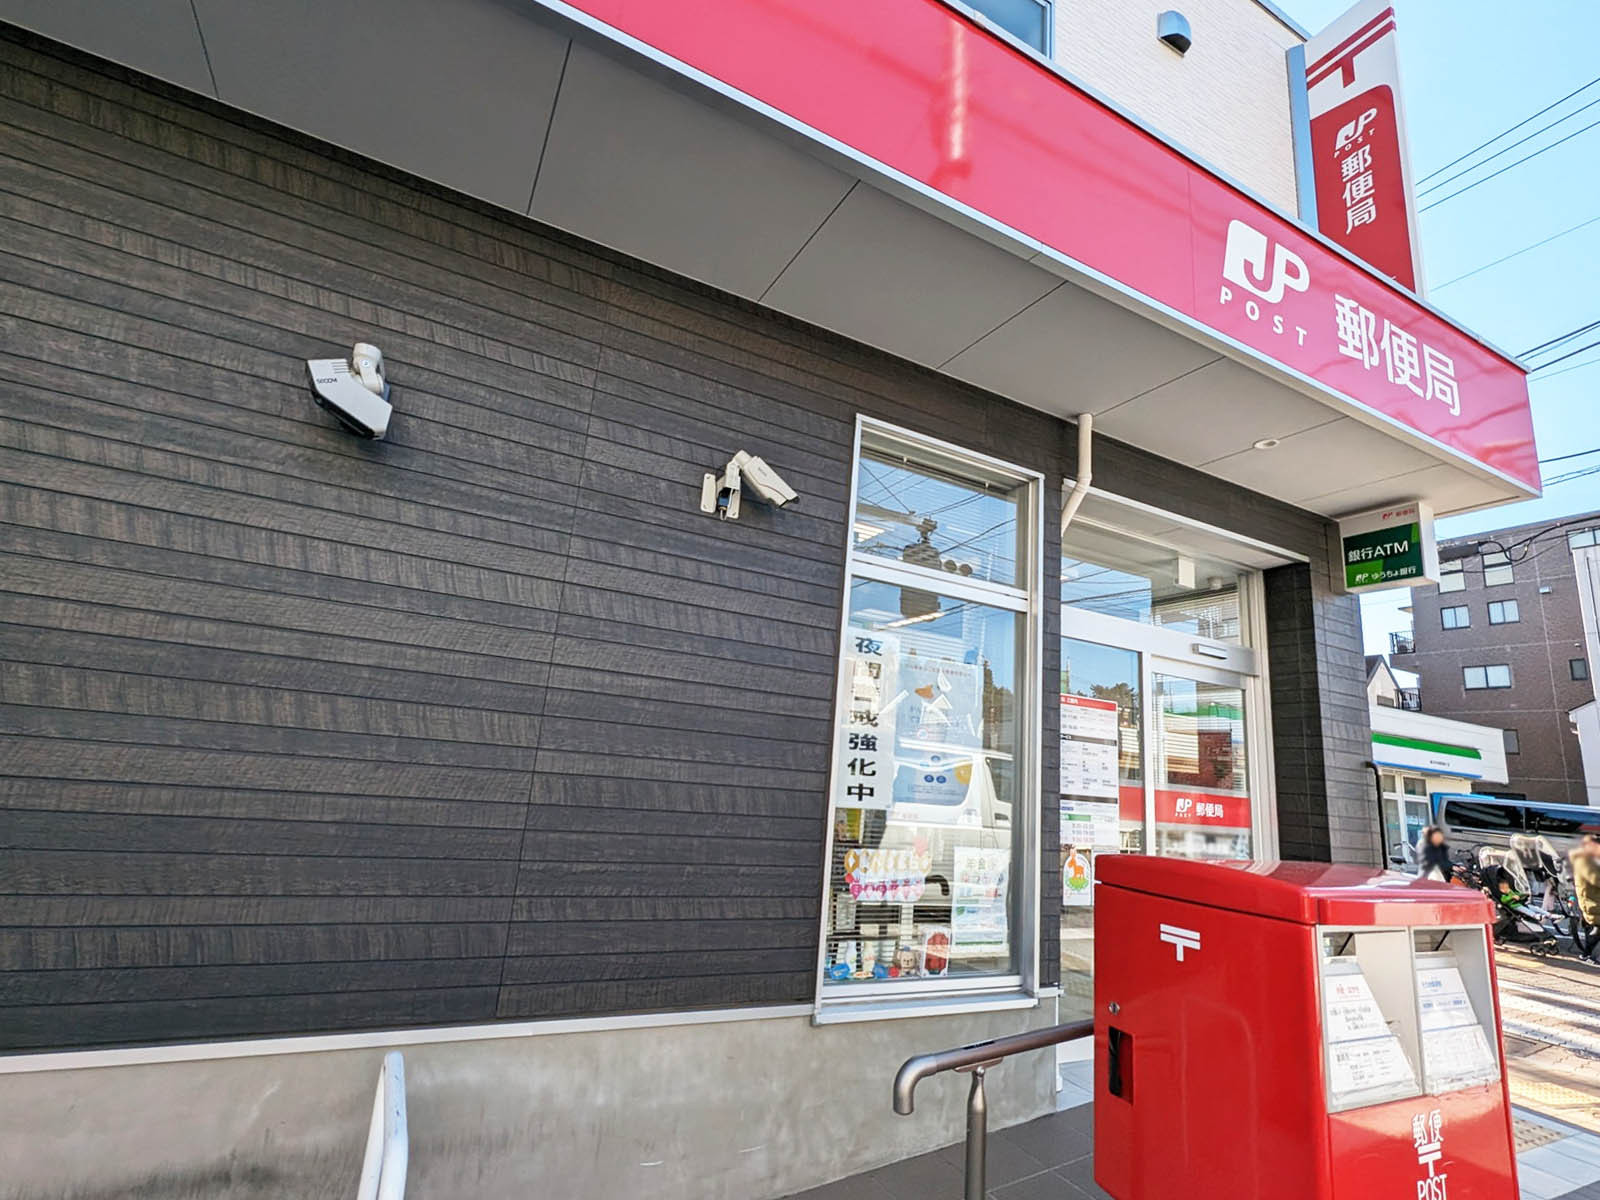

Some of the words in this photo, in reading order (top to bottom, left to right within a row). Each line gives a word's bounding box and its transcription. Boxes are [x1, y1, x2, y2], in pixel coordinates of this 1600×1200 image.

[1333, 127, 1376, 159] POST
[1335, 107, 1377, 151] JP
[1341, 143, 1377, 235] 郵便局
[1222, 218, 1310, 304] JP
[1219, 286, 1307, 346] POST
[1334, 293, 1462, 417] 郵便局
[1348, 540, 1409, 563] 銀行ATM
[1412, 1109, 1444, 1148] 郵便
[1417, 1174, 1447, 1200] POST
